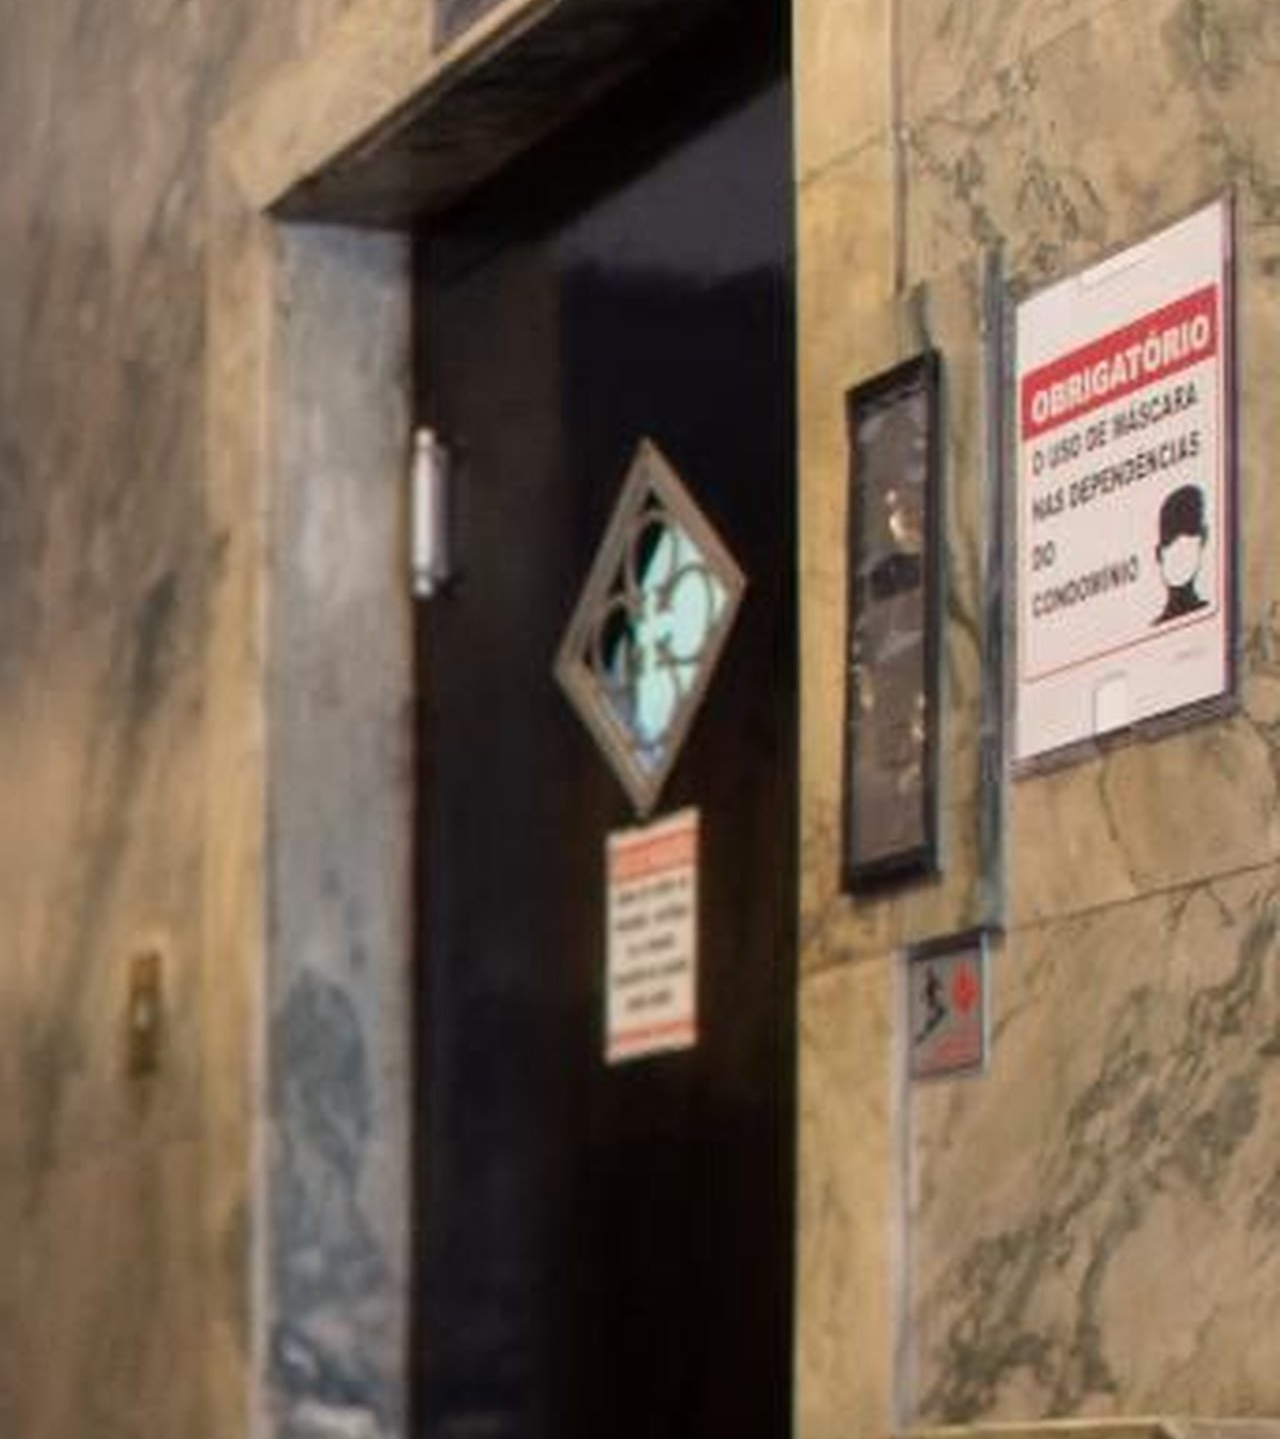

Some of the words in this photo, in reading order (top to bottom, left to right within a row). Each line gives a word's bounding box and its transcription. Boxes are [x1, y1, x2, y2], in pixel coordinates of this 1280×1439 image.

[1031, 314, 1210, 423] OBRIGATÓRIO
[1032, 449, 1045, 477] O
[1049, 433, 1082, 469] USO
[1085, 419, 1107, 452] DE
[1032, 486, 1065, 521] NAS
[1032, 540, 1056, 571] DO
